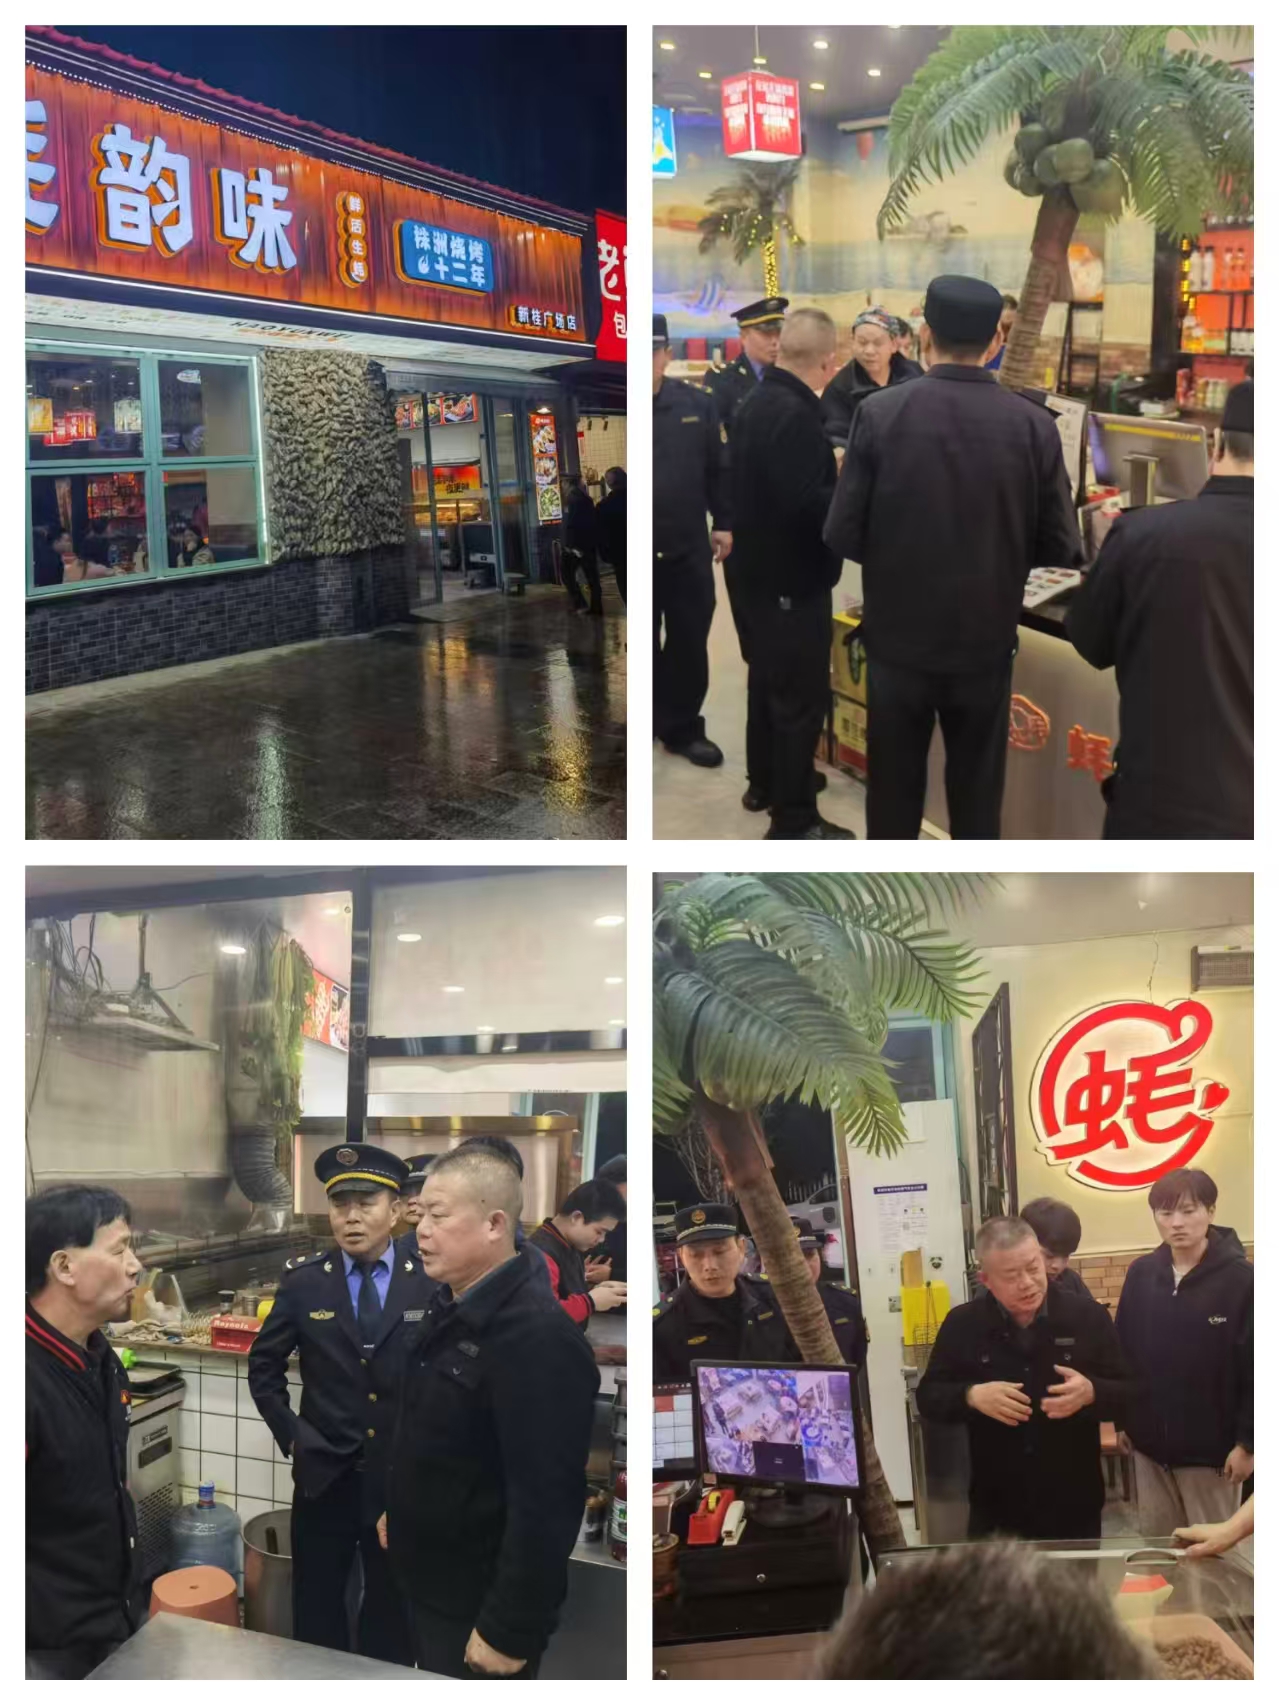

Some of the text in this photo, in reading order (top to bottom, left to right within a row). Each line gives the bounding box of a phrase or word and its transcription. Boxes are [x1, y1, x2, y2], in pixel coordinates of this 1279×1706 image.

[414, 225, 484, 263] 株洲烧烤
[434, 256, 486, 287] 十二年
[598, 239, 627, 301] 老
[518, 306, 576, 331] 新桂广场店
